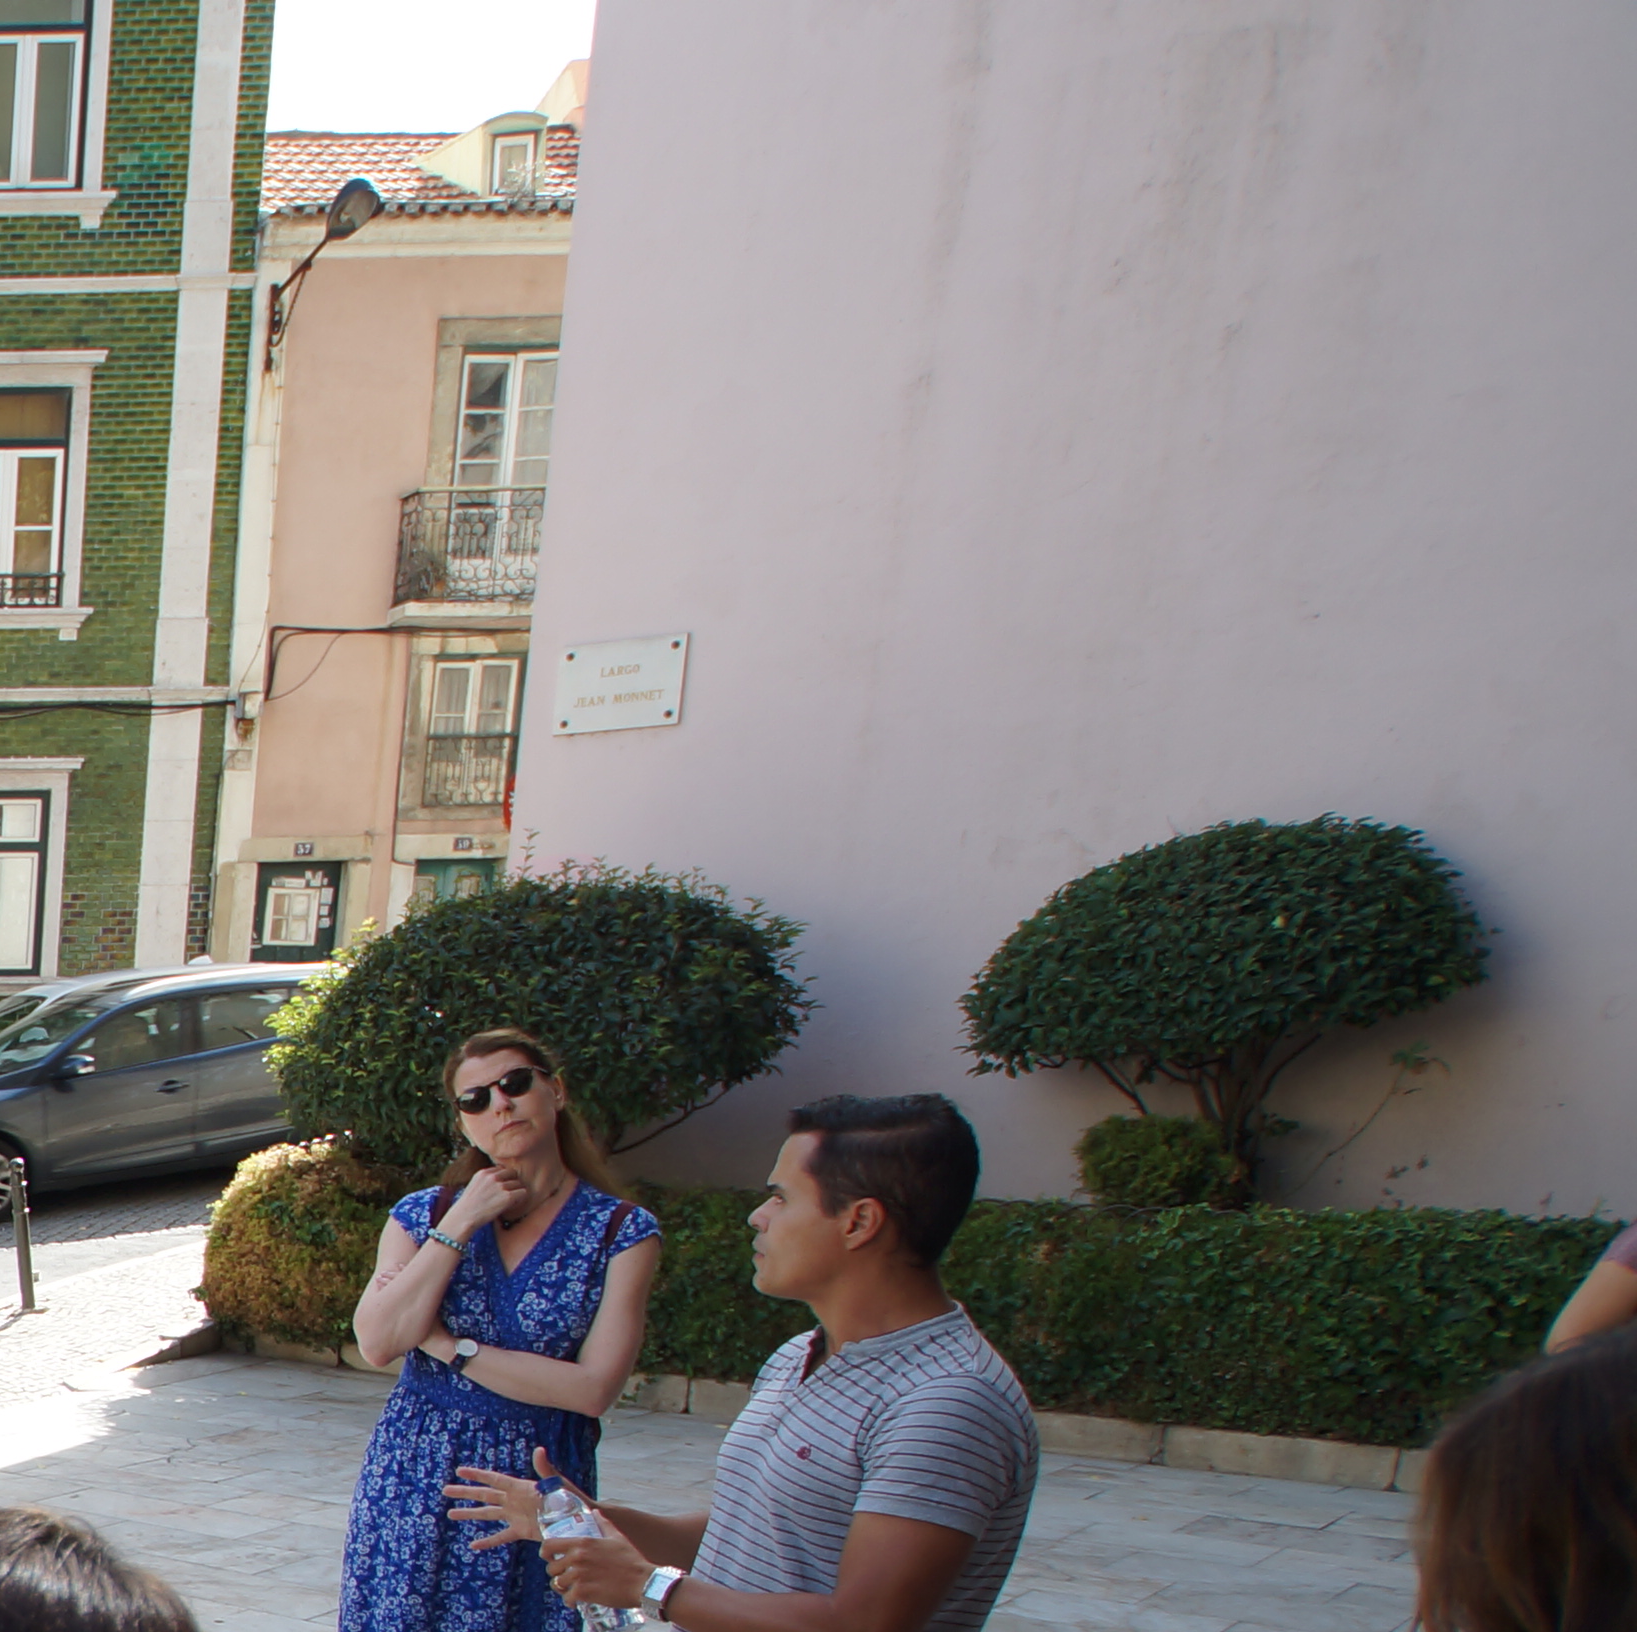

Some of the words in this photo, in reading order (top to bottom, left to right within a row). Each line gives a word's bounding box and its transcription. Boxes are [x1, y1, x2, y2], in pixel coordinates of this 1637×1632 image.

[600, 664, 640, 678] LARGO
[573, 695, 605, 708] JEAN
[612, 689, 665, 704] MONNET
